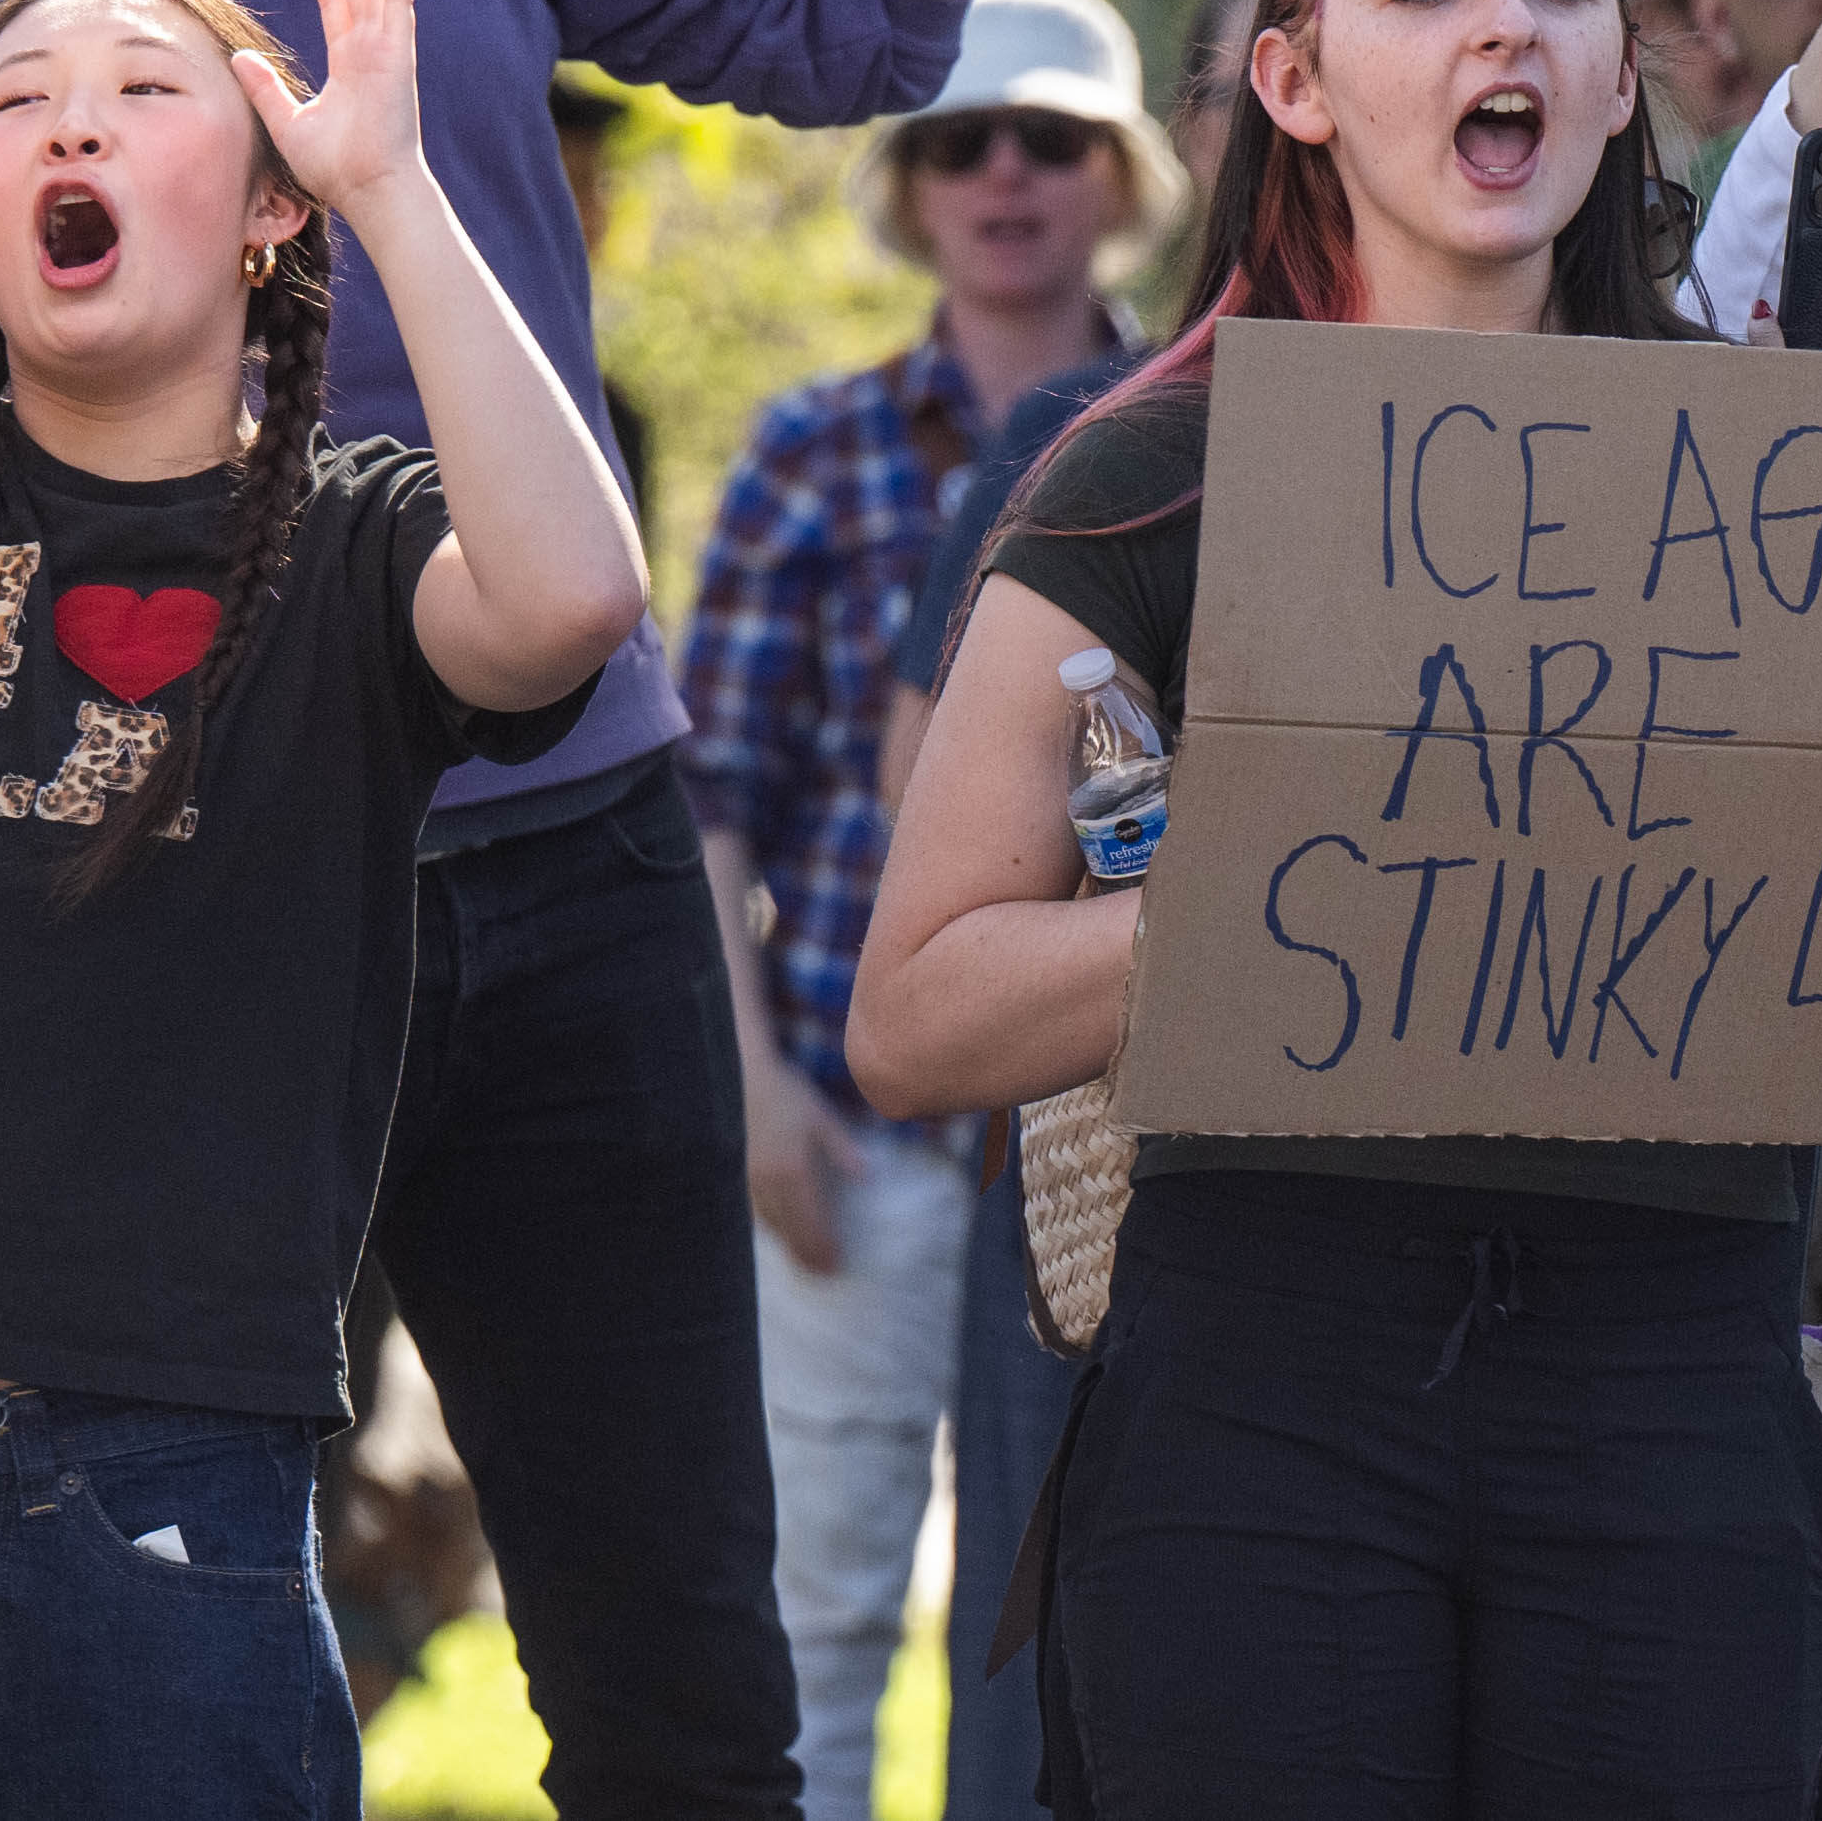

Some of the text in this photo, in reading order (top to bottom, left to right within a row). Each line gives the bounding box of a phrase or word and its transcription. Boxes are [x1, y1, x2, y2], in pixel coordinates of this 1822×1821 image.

[1380, 401, 1597, 602] ICE
[1379, 639, 1743, 839] ARE
[1265, 833, 1769, 1080] STINKY
